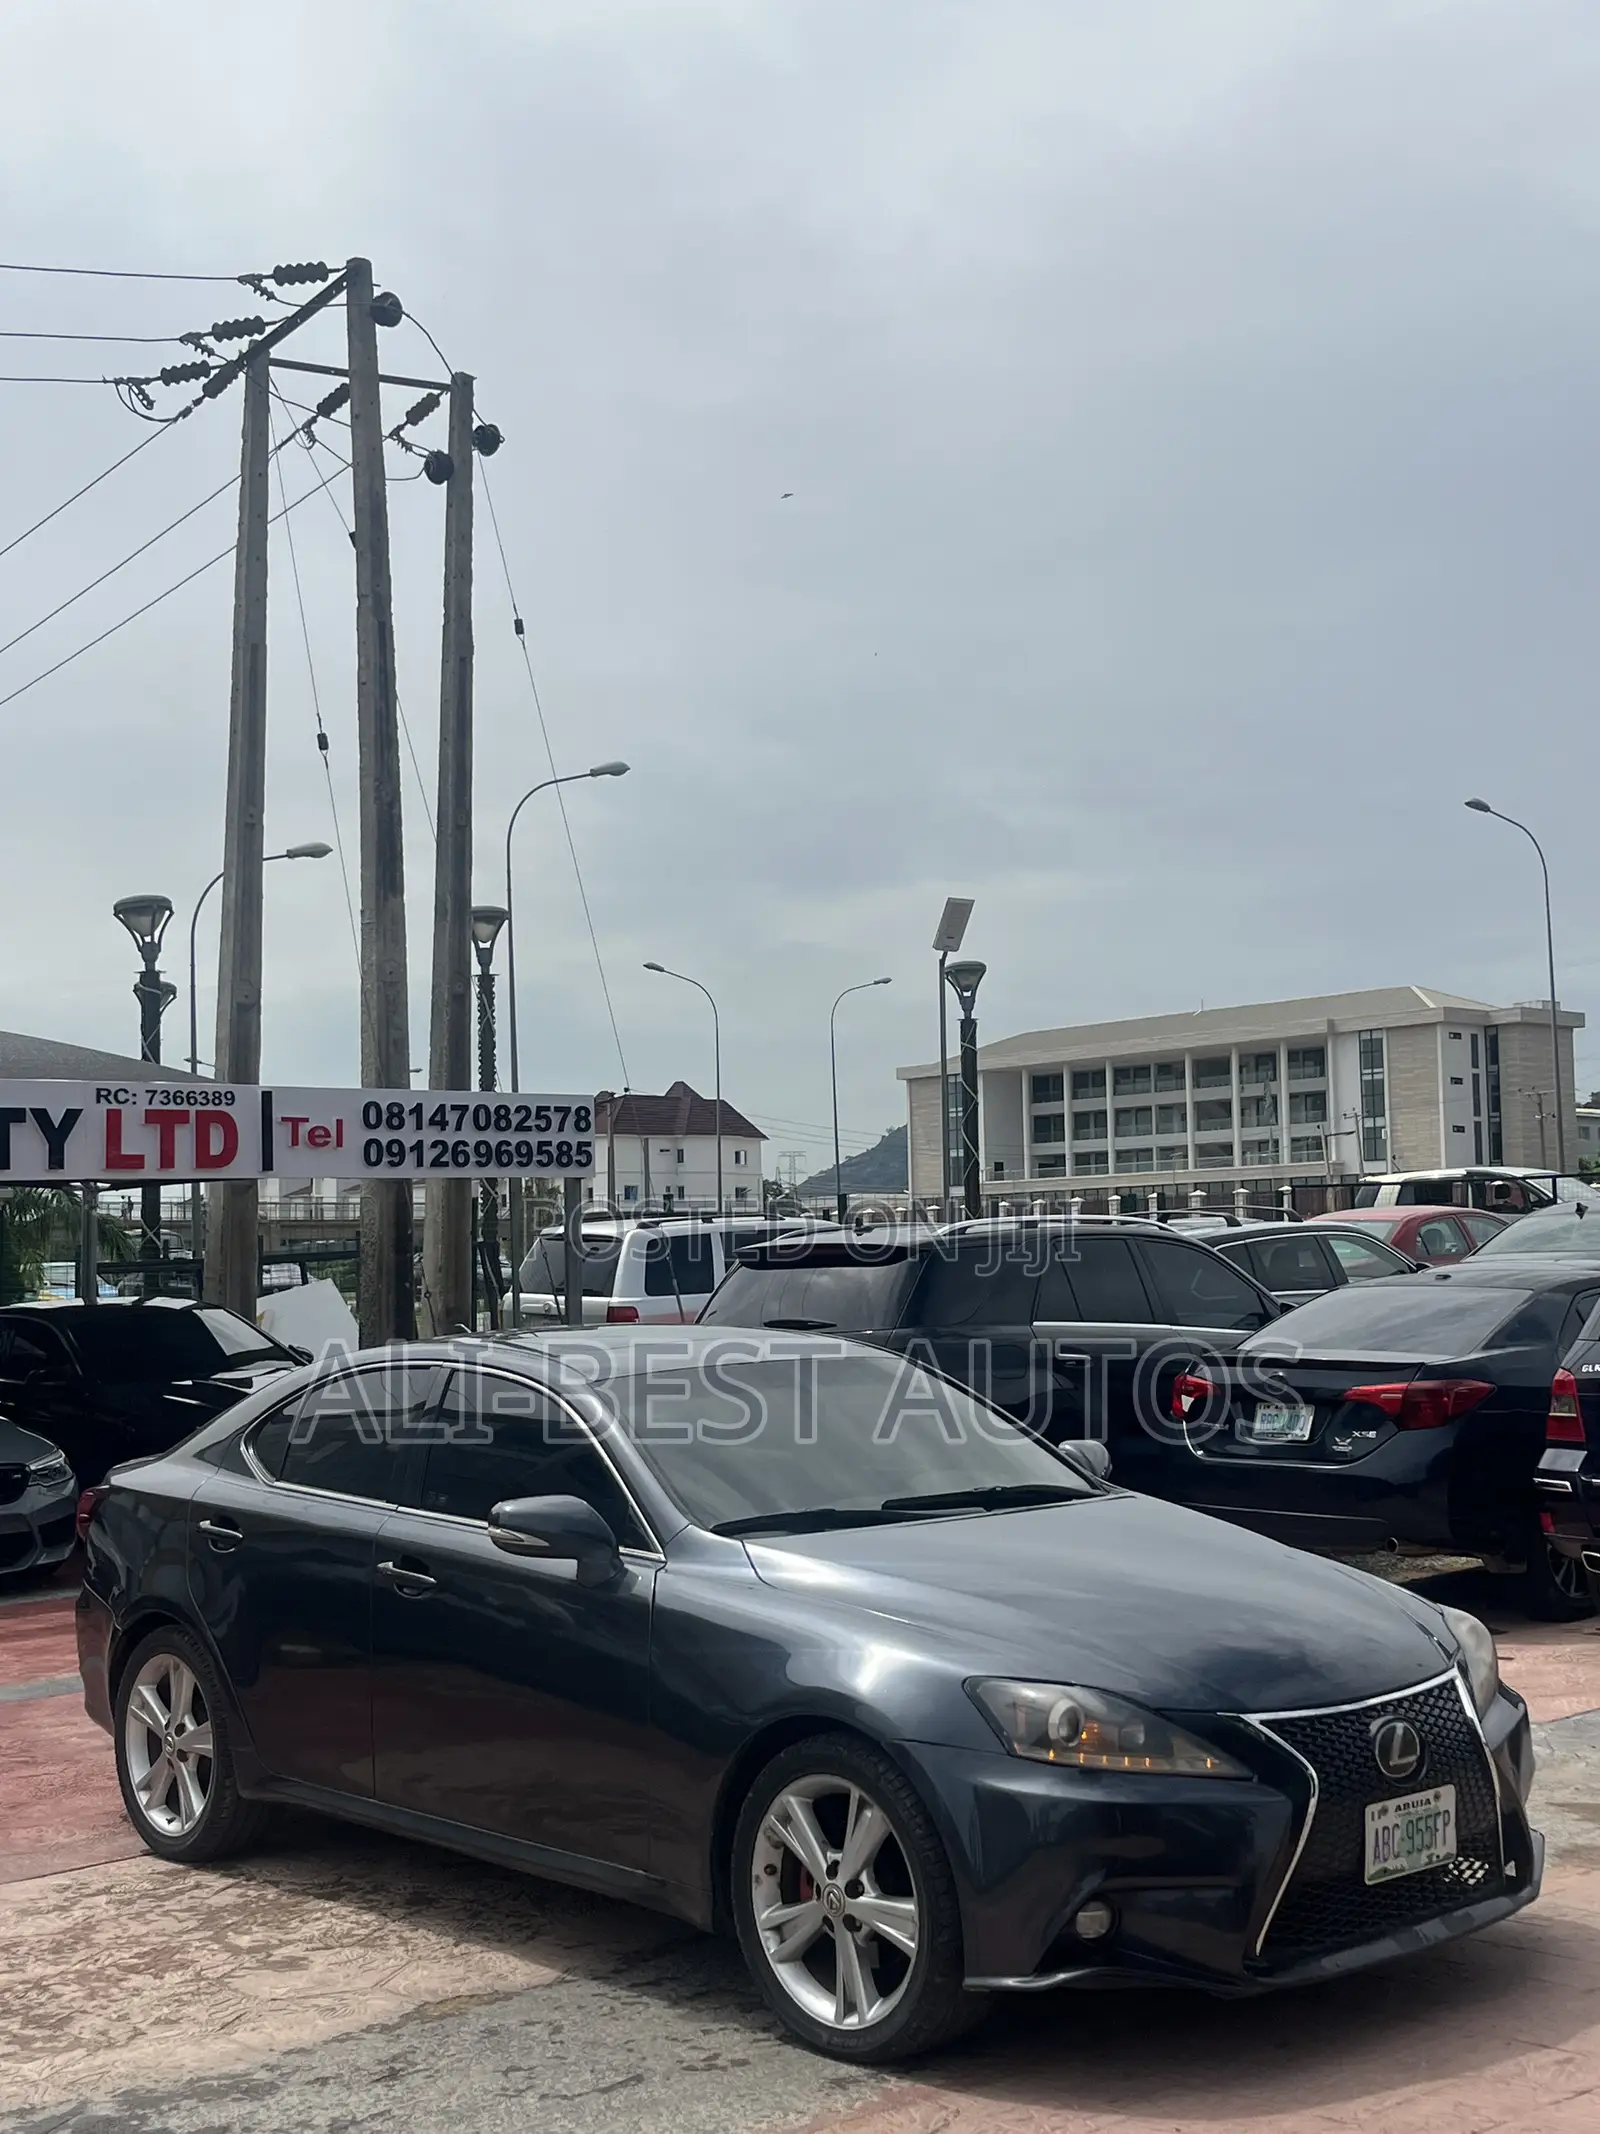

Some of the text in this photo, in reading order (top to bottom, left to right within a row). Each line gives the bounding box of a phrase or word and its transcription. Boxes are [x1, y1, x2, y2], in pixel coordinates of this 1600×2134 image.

[95, 1087, 236, 1107] RC: 7366389
[281, 1116, 344, 1148] Tel
[361, 1100, 592, 1133] 08147082578
[105, 1108, 239, 1170] LTD
[363, 1138, 594, 1169] 09126969585
[1394, 1798, 1432, 1813] ABUJA
